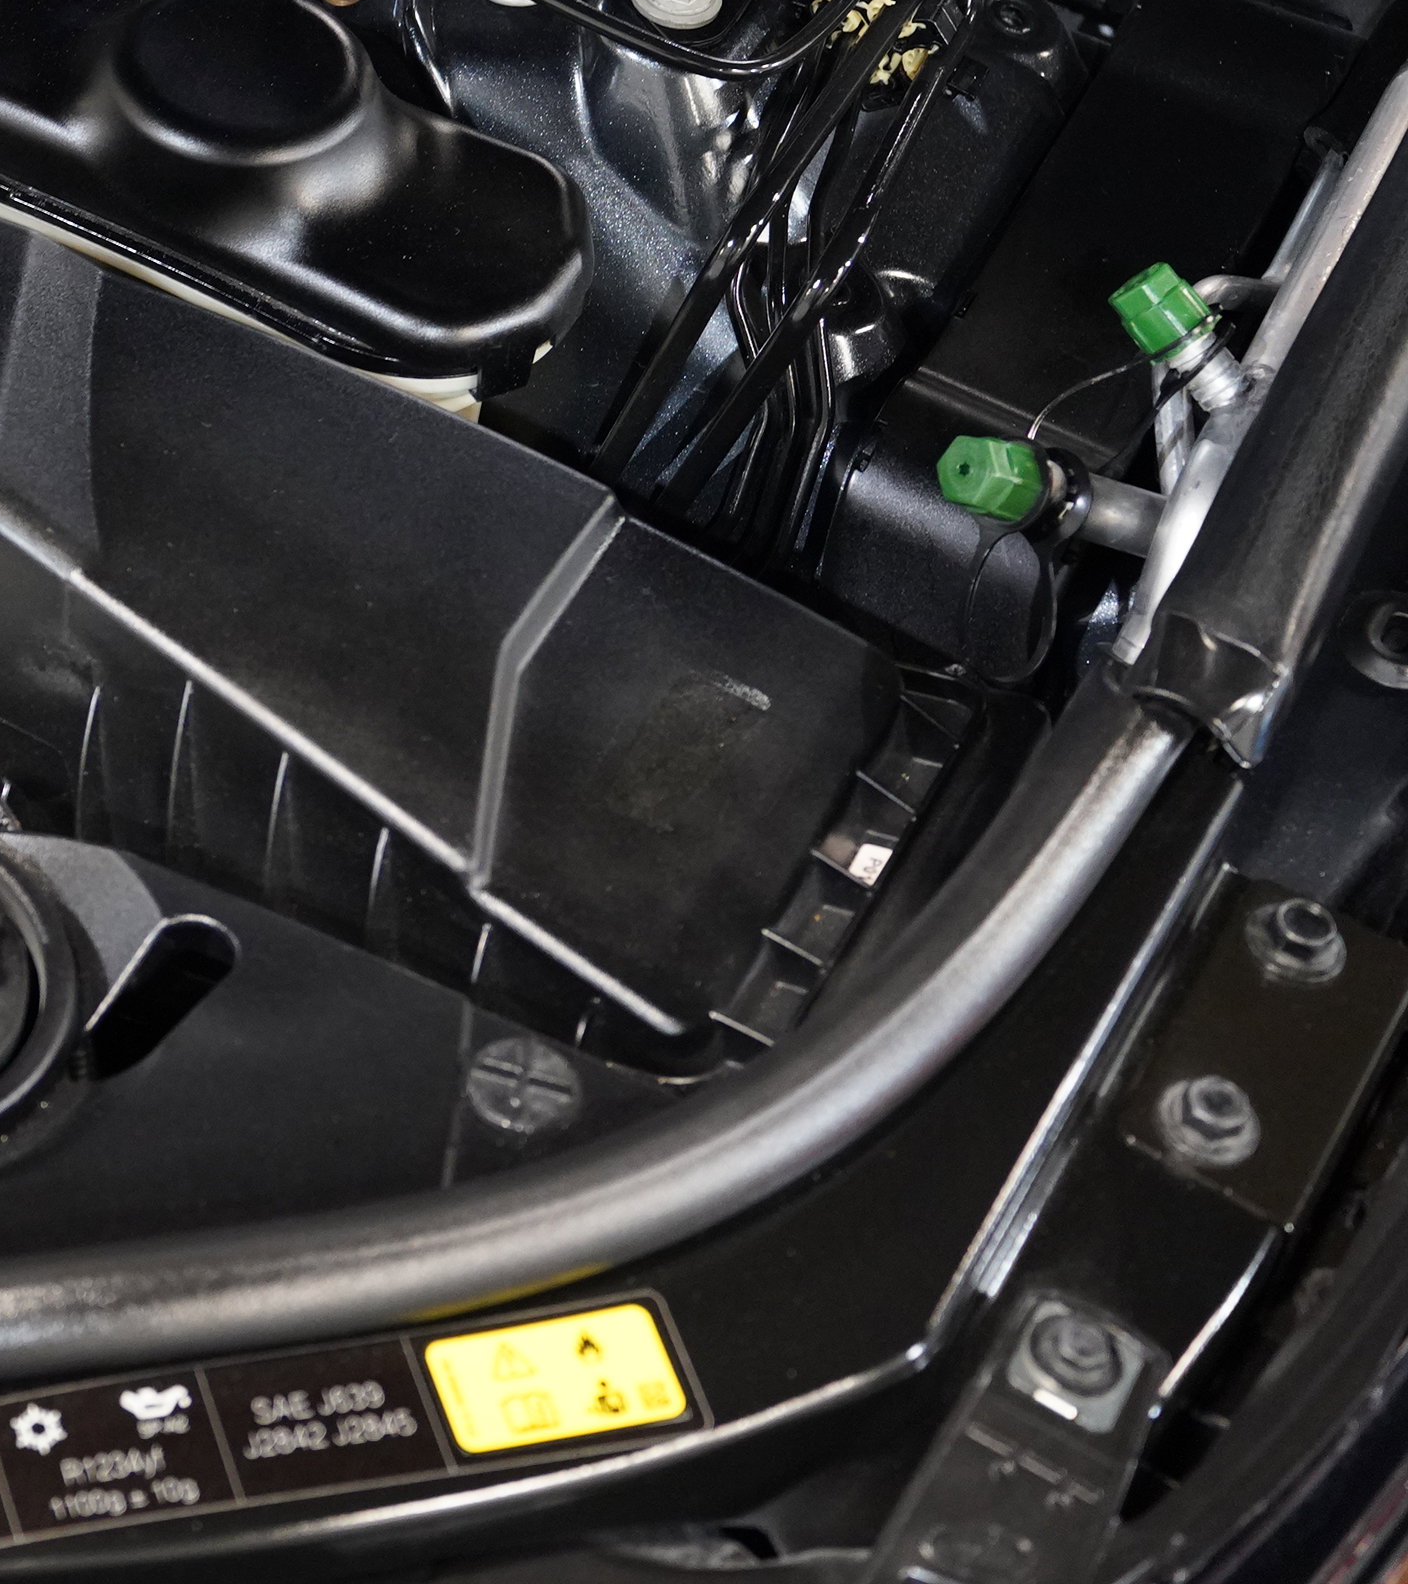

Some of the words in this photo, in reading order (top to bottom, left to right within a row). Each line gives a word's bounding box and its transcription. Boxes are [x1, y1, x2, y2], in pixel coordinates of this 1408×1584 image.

[250, 1389, 317, 1426] SAE
[316, 1379, 386, 1417] J639
[59, 1441, 167, 1487] R1234yf
